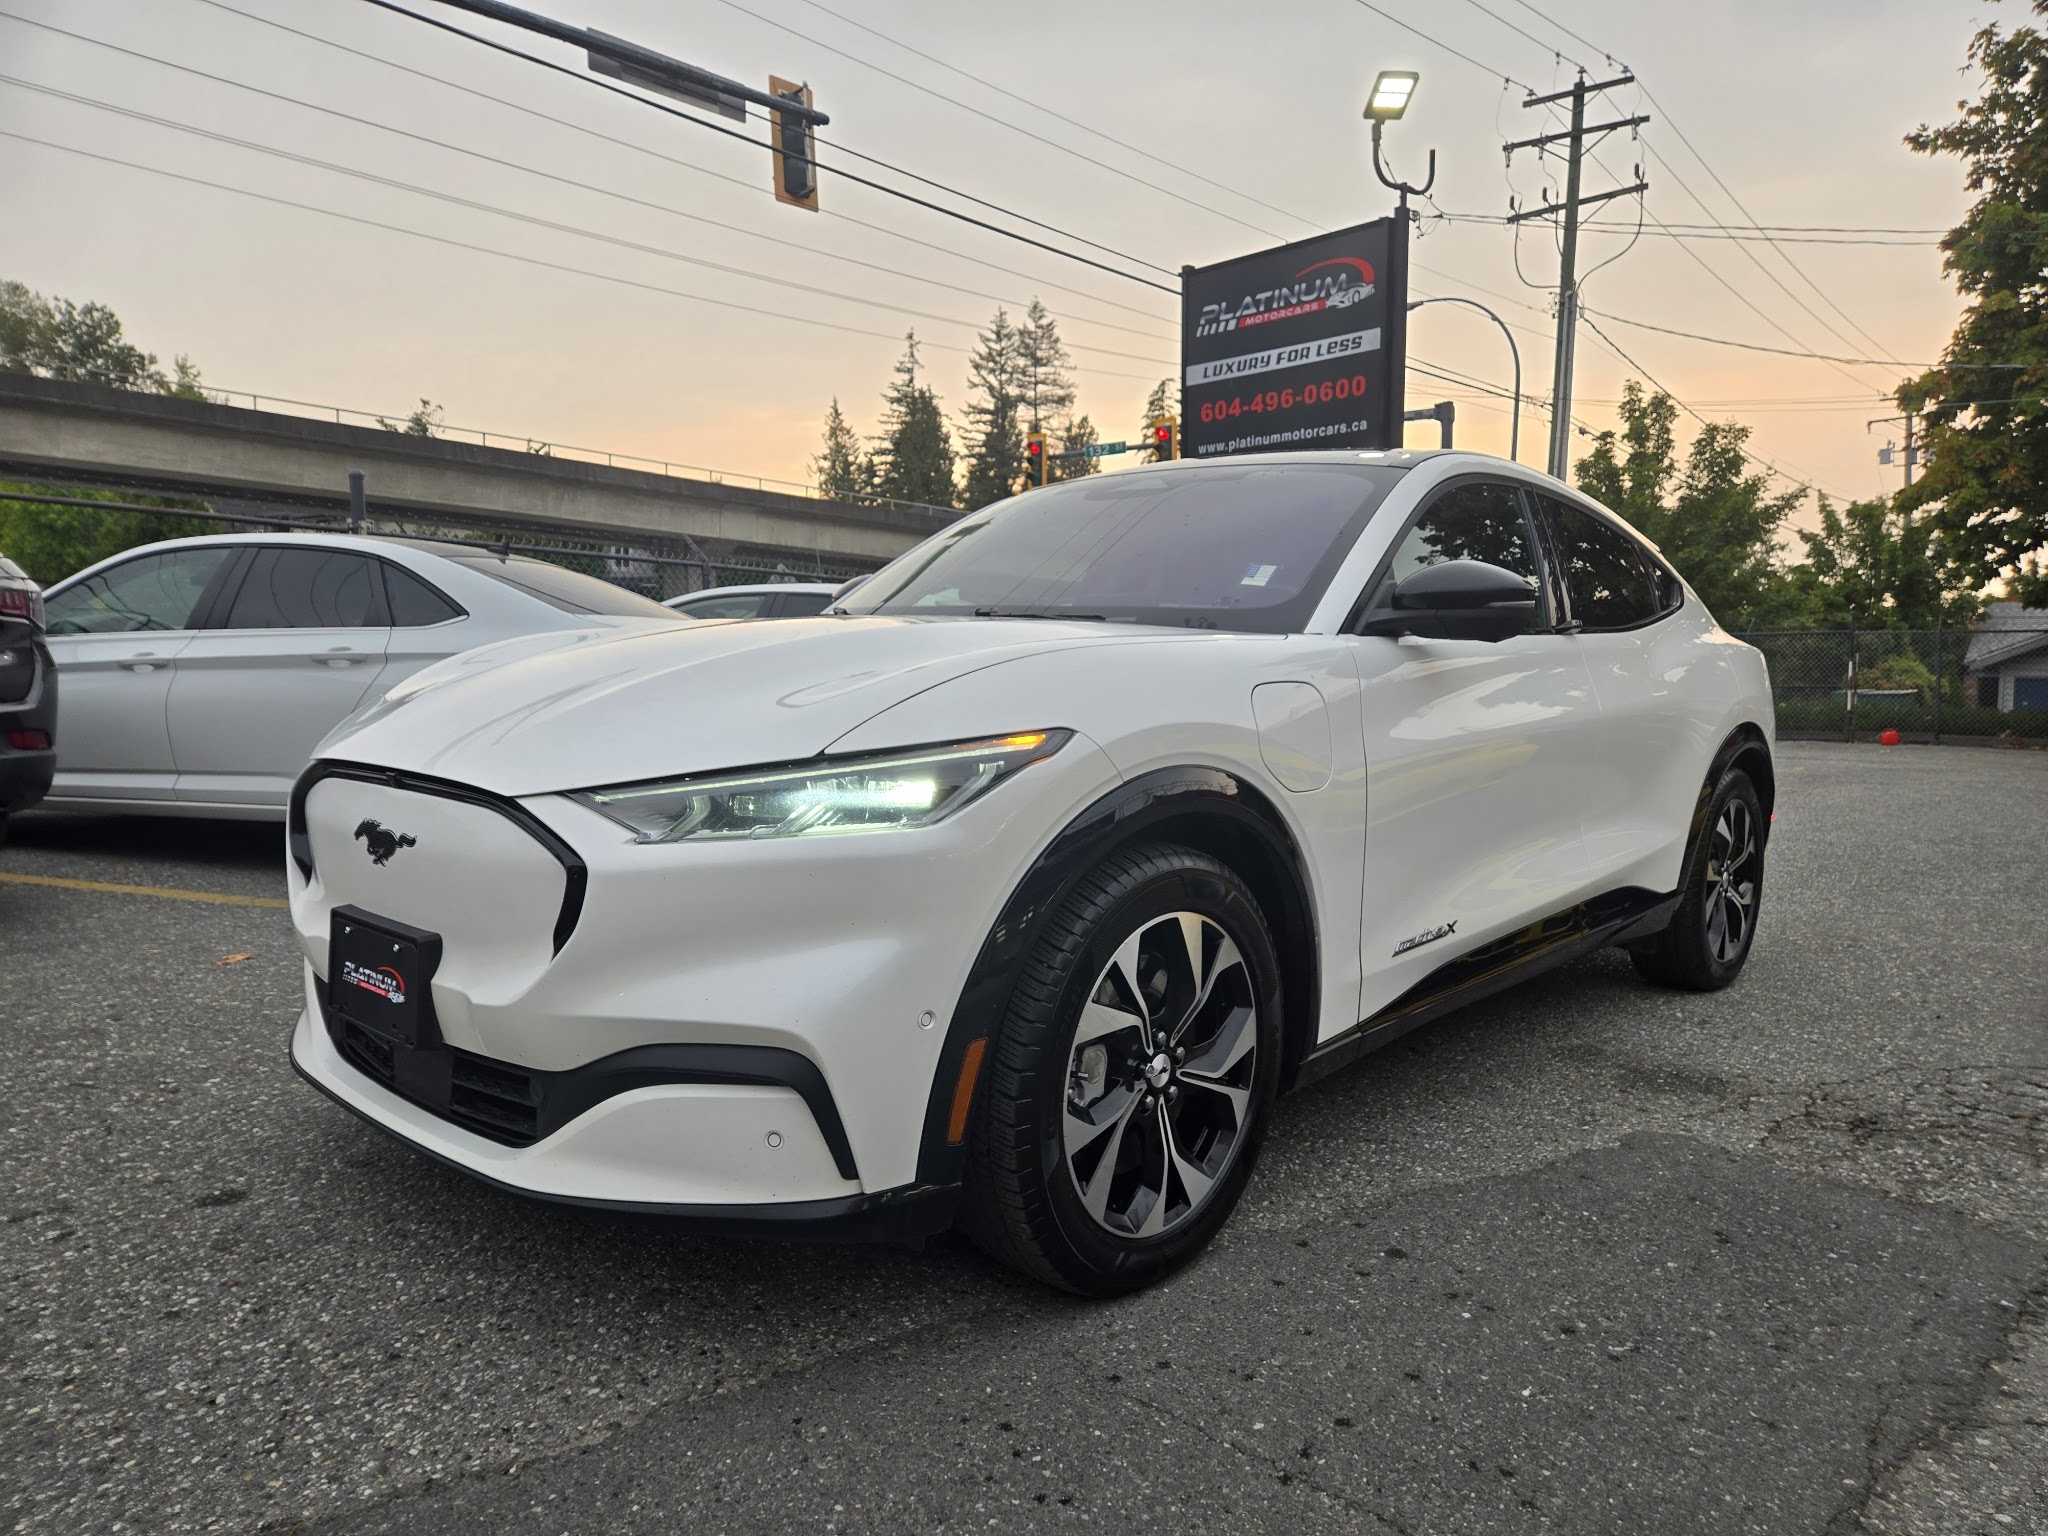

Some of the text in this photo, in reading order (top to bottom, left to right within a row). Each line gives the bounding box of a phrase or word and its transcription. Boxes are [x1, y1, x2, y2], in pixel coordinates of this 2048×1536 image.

[1200, 273, 1348, 324] PLATINUM
[1245, 302, 1319, 325] MOTORCARS
[1203, 354, 1271, 379] LUXURY
[1276, 346, 1310, 365] FOR
[1201, 376, 1366, 422] 604-496-0600
[1089, 444, 1110, 456] 132
[1198, 420, 1367, 453] www.platinummotorcars.ca
[343, 961, 397, 991] PLATINUM
